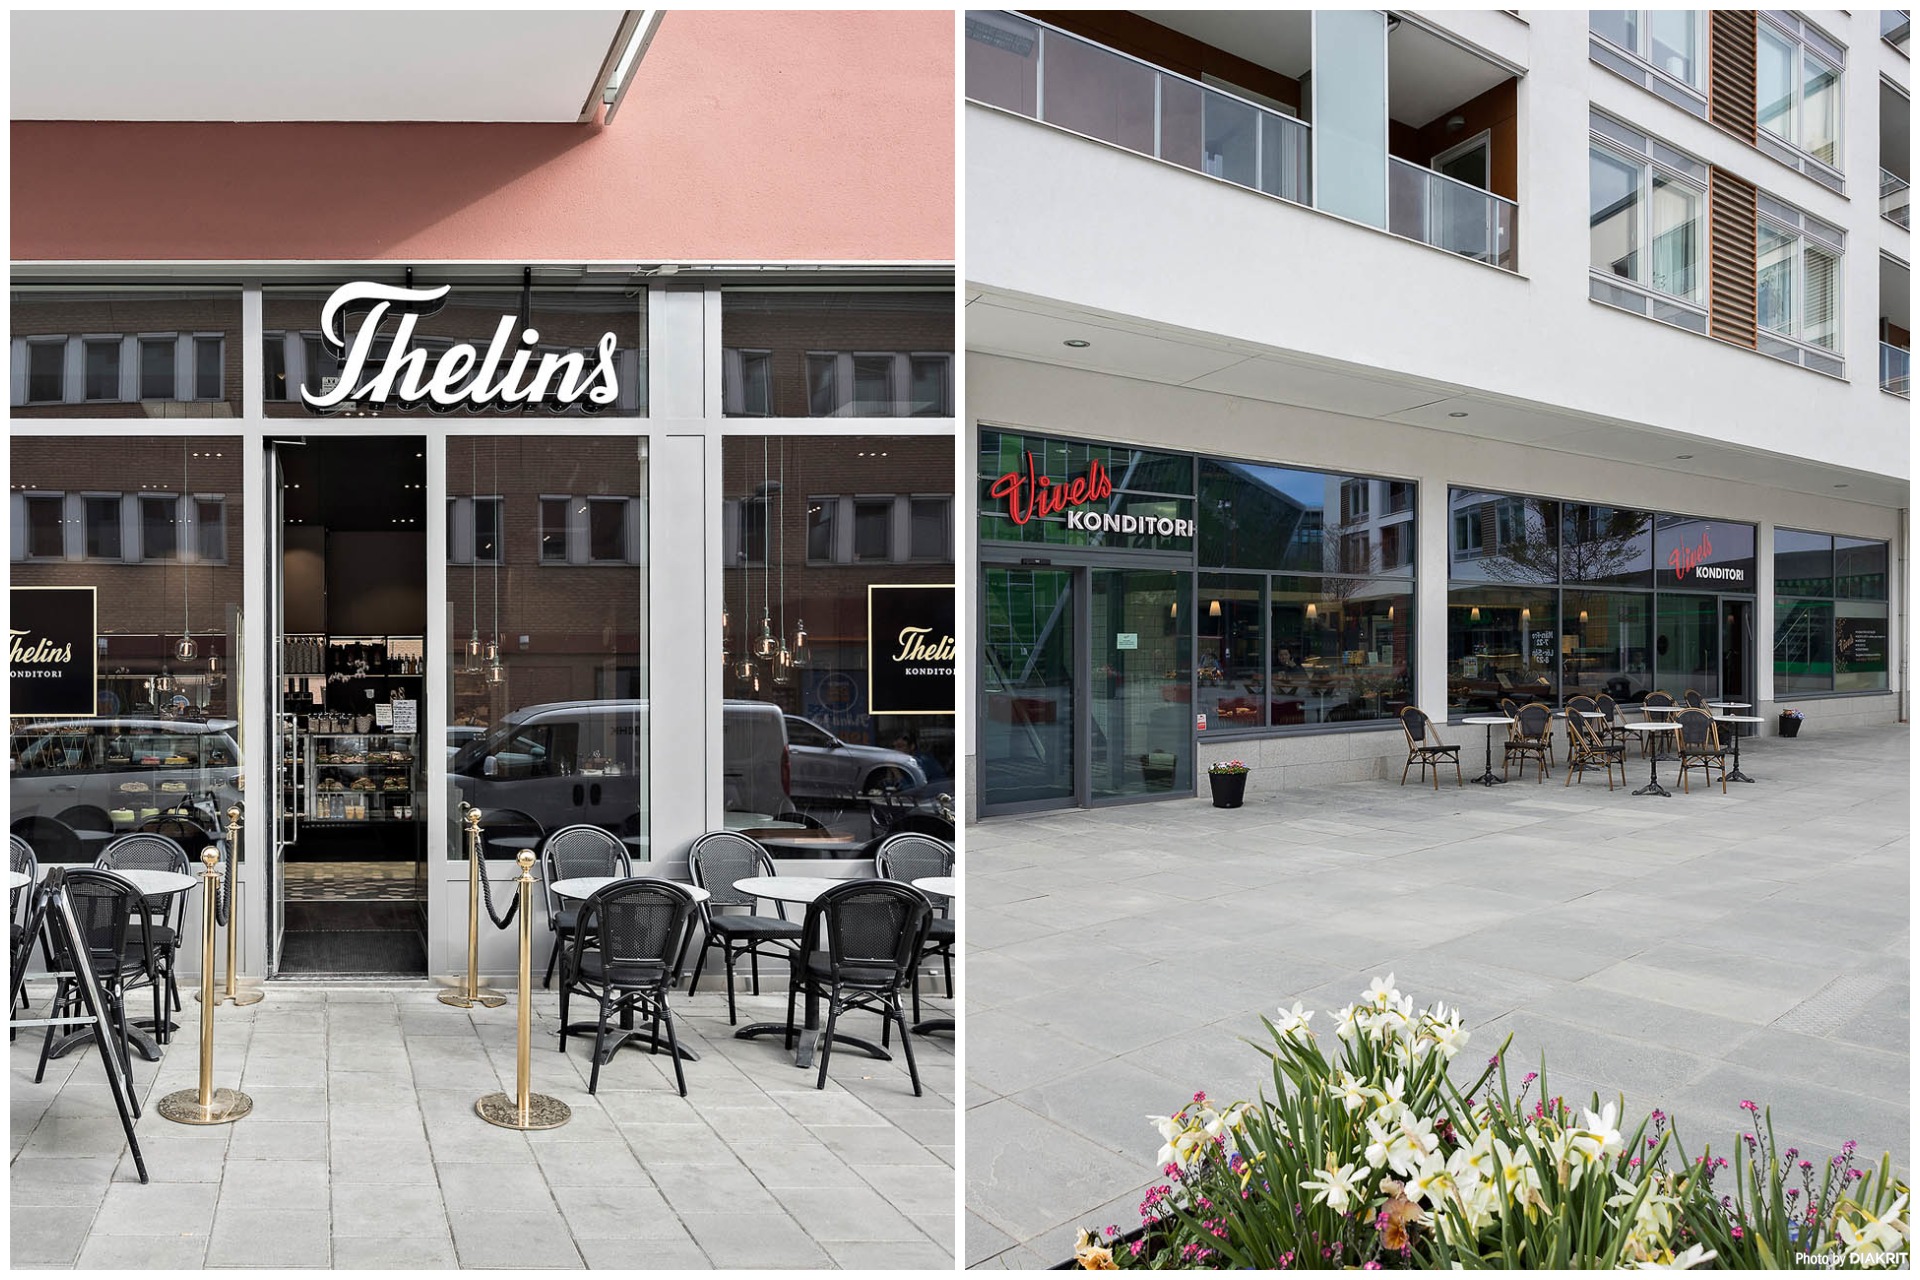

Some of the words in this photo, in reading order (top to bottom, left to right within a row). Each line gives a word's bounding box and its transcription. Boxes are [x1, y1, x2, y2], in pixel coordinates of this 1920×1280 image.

[300, 281, 619, 407] Thelins
[991, 450, 1112, 525] Vivels
[1067, 510, 1194, 537] KONDITORI
[1668, 533, 1712, 580] Vivels
[1696, 566, 1744, 580] KONDITORI
[892, 626, 955, 661] Theli
[10, 670, 62, 678] ONDITORI
